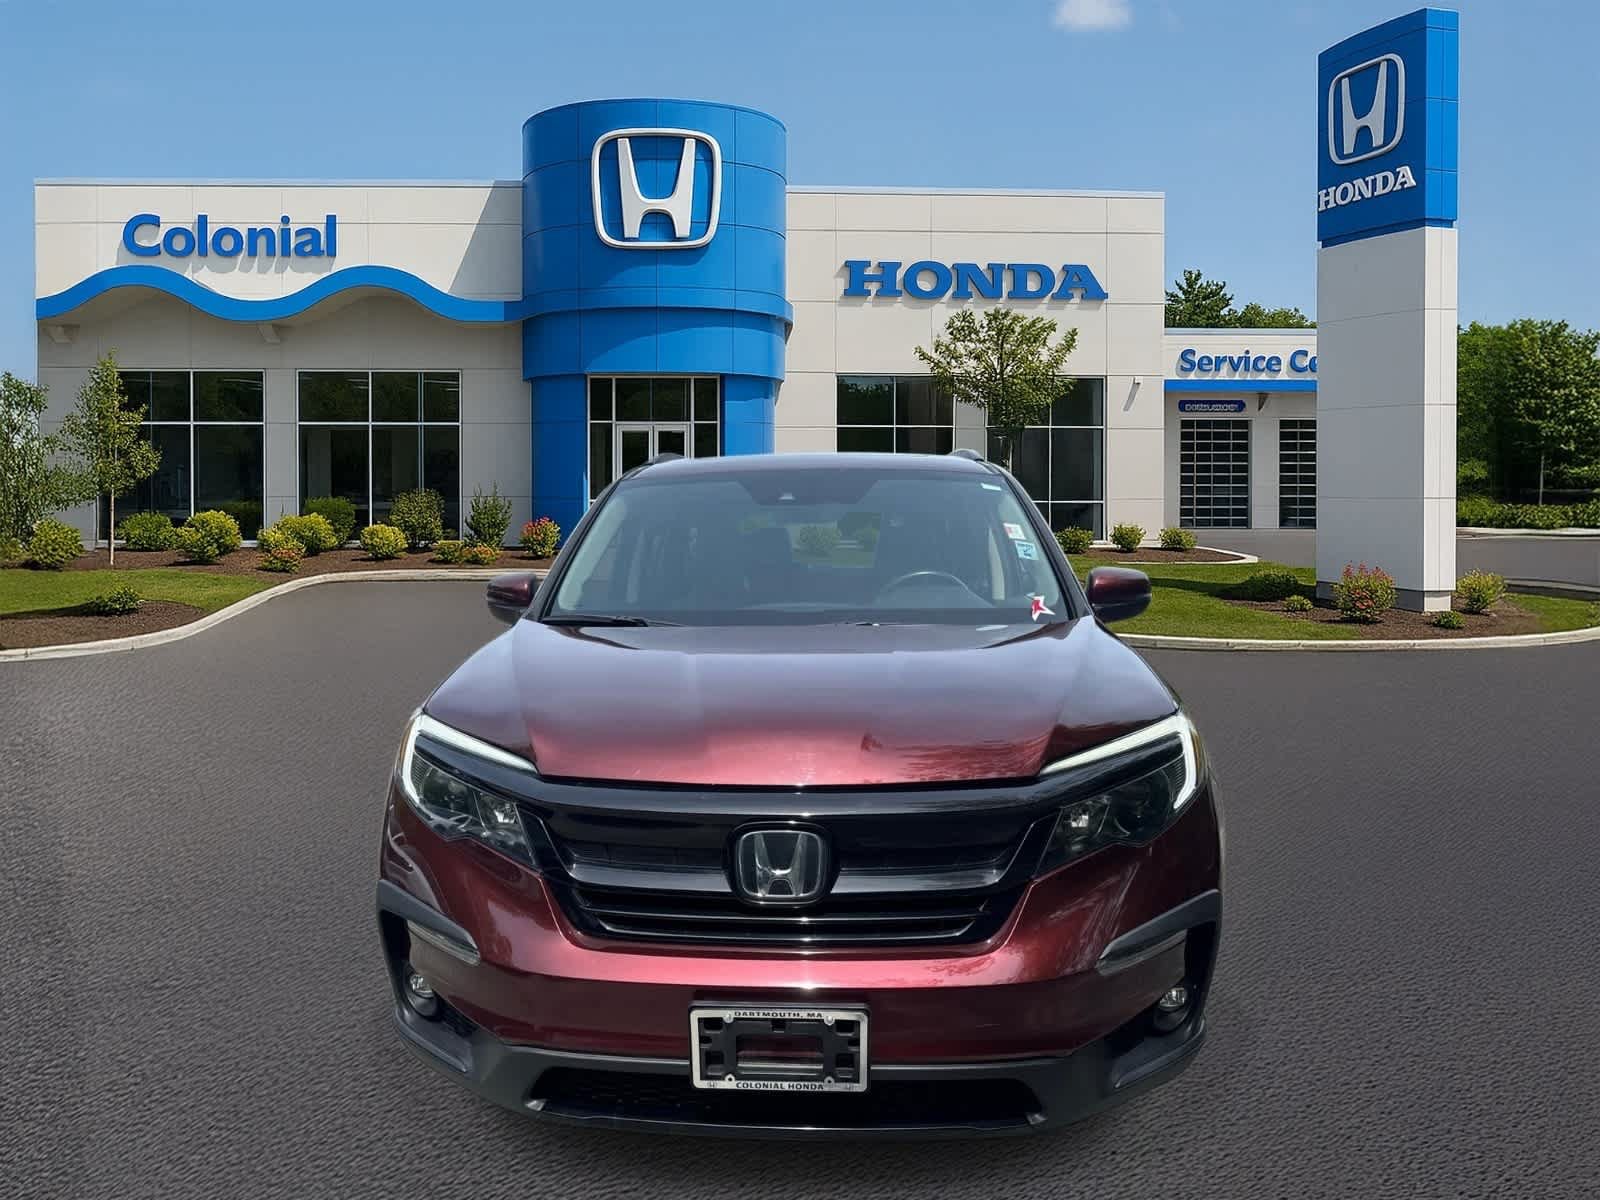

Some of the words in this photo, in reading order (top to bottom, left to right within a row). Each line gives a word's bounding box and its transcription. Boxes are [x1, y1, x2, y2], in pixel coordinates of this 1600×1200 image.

[1318, 165, 1416, 212] HONDA
[122, 213, 337, 257] Colonial
[843, 260, 1109, 300] HONDA
[1180, 348, 1282, 373] Service
[735, 1081, 785, 1090] COLONIAL
[787, 1082, 824, 1091] HONDA
